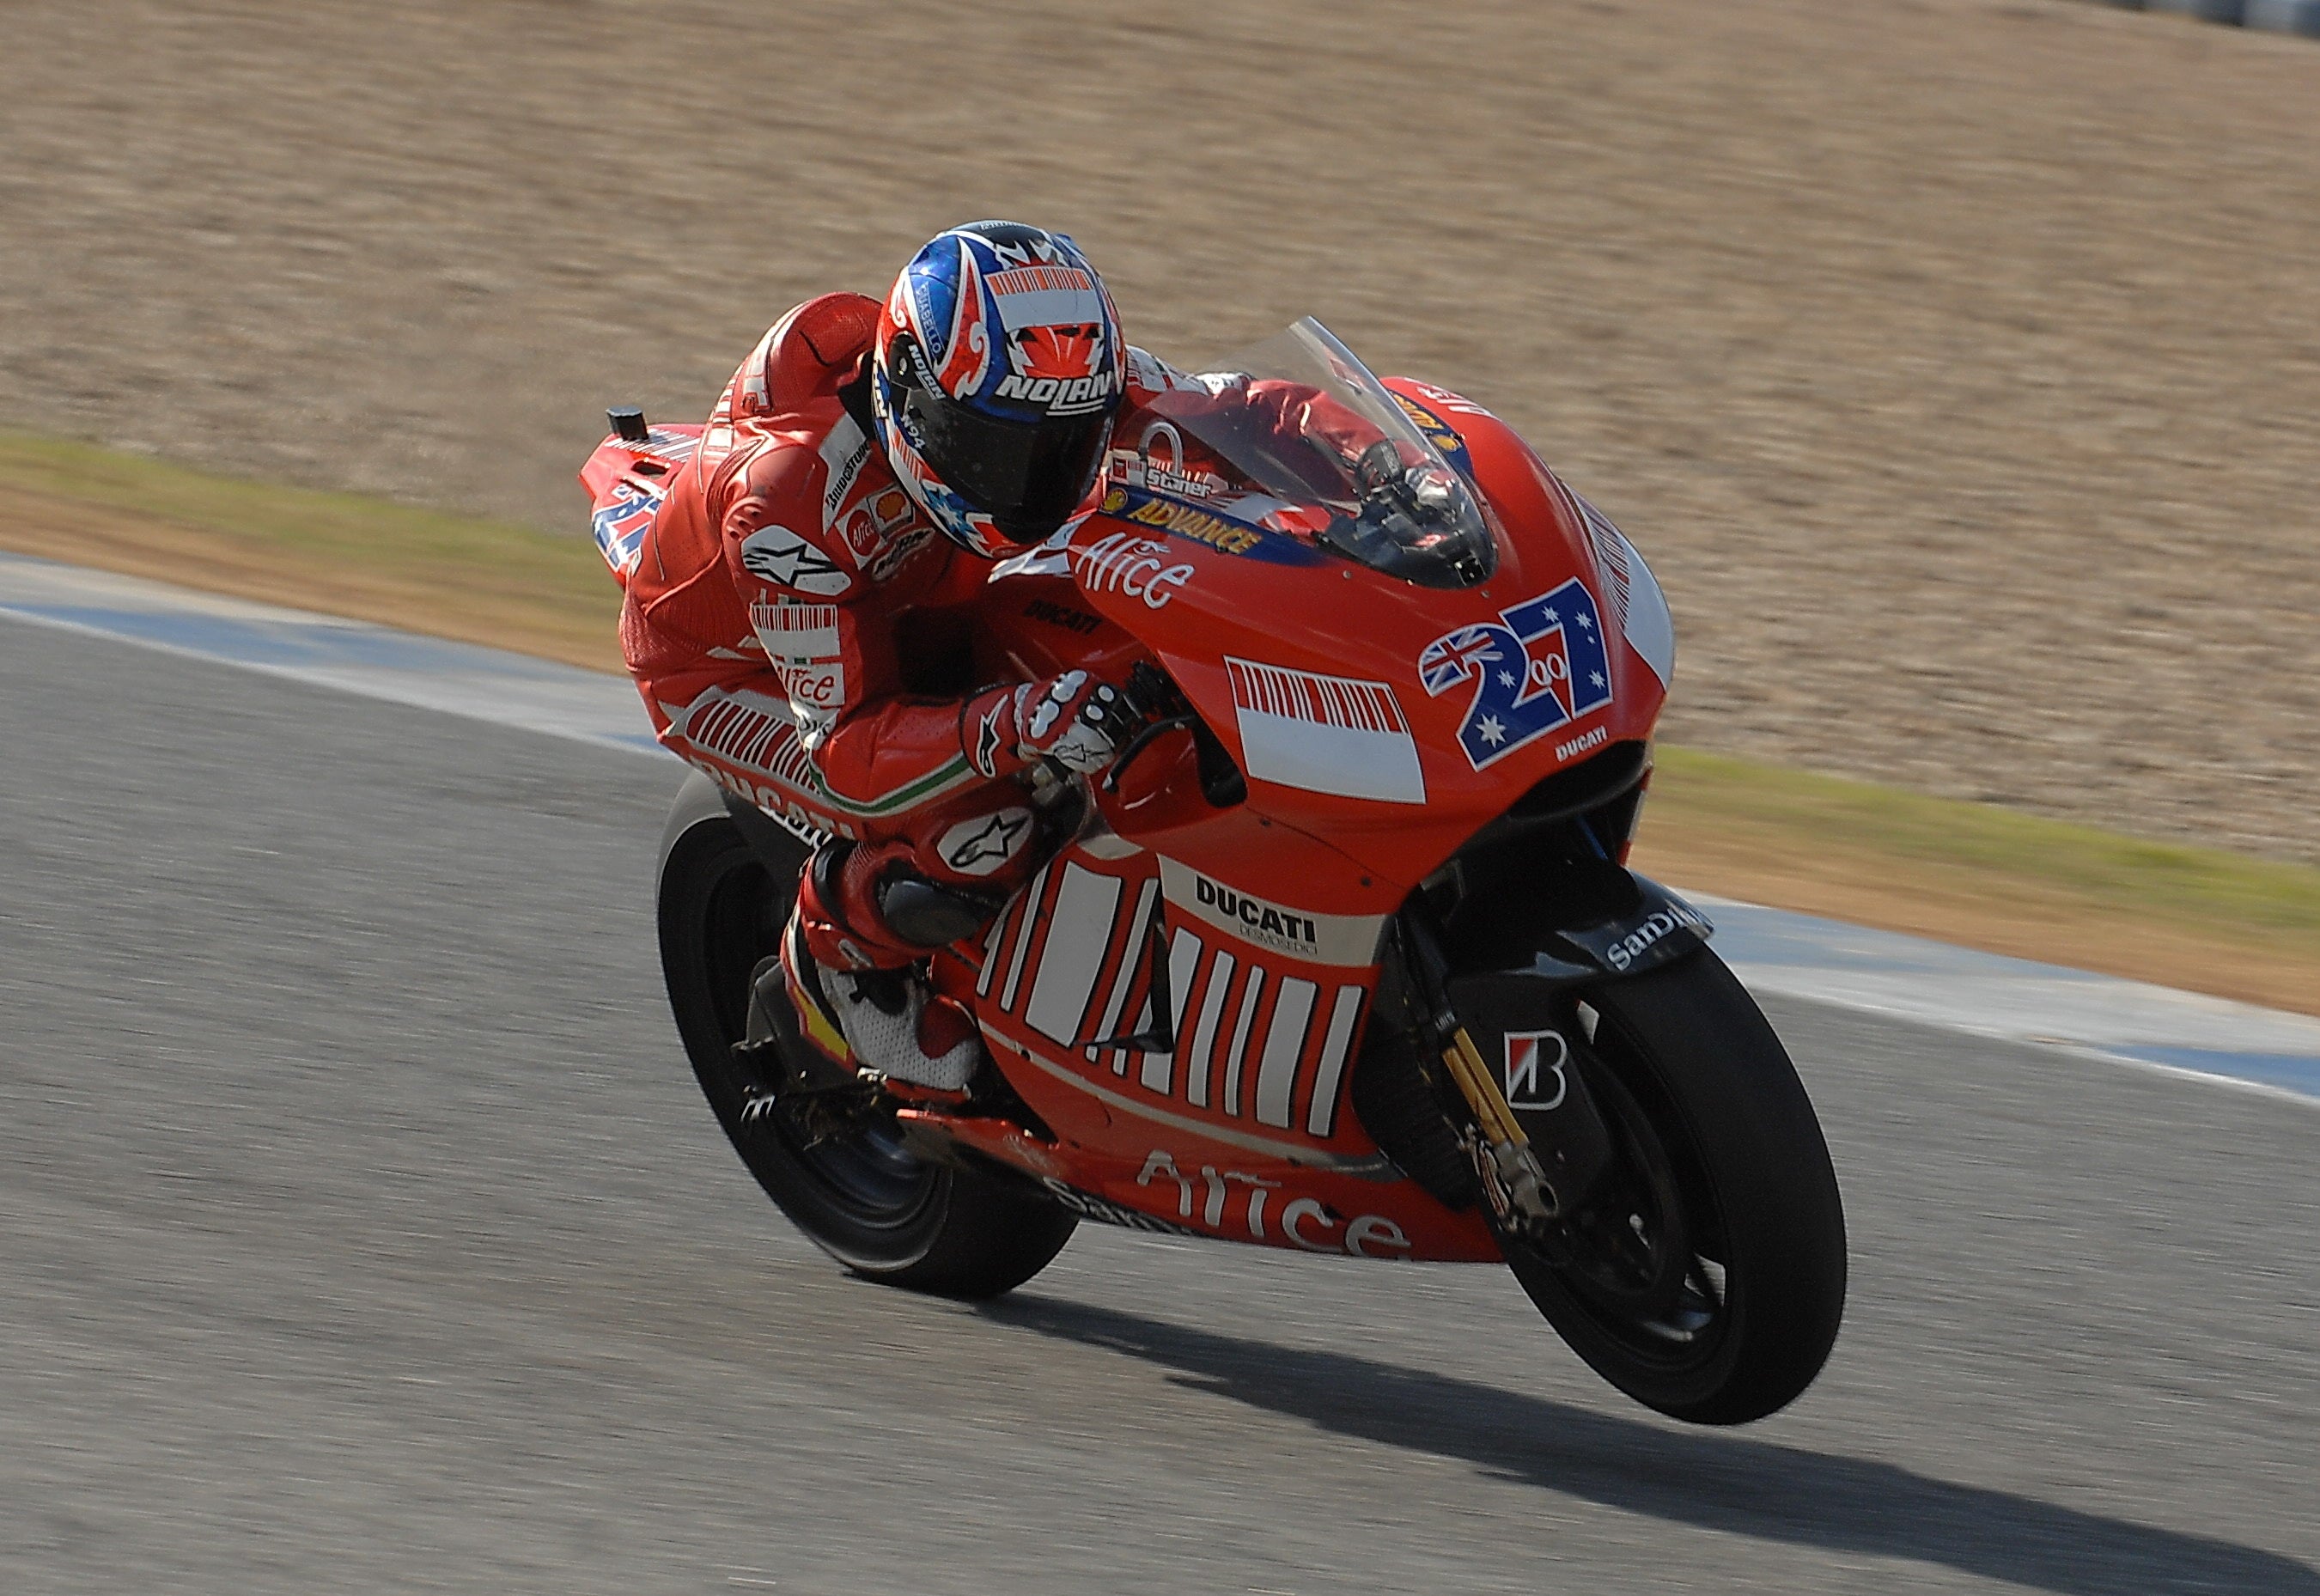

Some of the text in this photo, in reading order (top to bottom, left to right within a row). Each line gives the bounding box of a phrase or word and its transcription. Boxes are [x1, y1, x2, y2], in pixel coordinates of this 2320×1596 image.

[908, 344, 946, 400] NOLAN
[995, 370, 1112, 415] NOLAN
[1127, 497, 1264, 554] ADVANCE
[1075, 533, 1195, 609] Alice
[1418, 576, 1614, 772] 27
[1555, 724, 1608, 763] DUCATI
[1196, 874, 1318, 944] DUCATI
